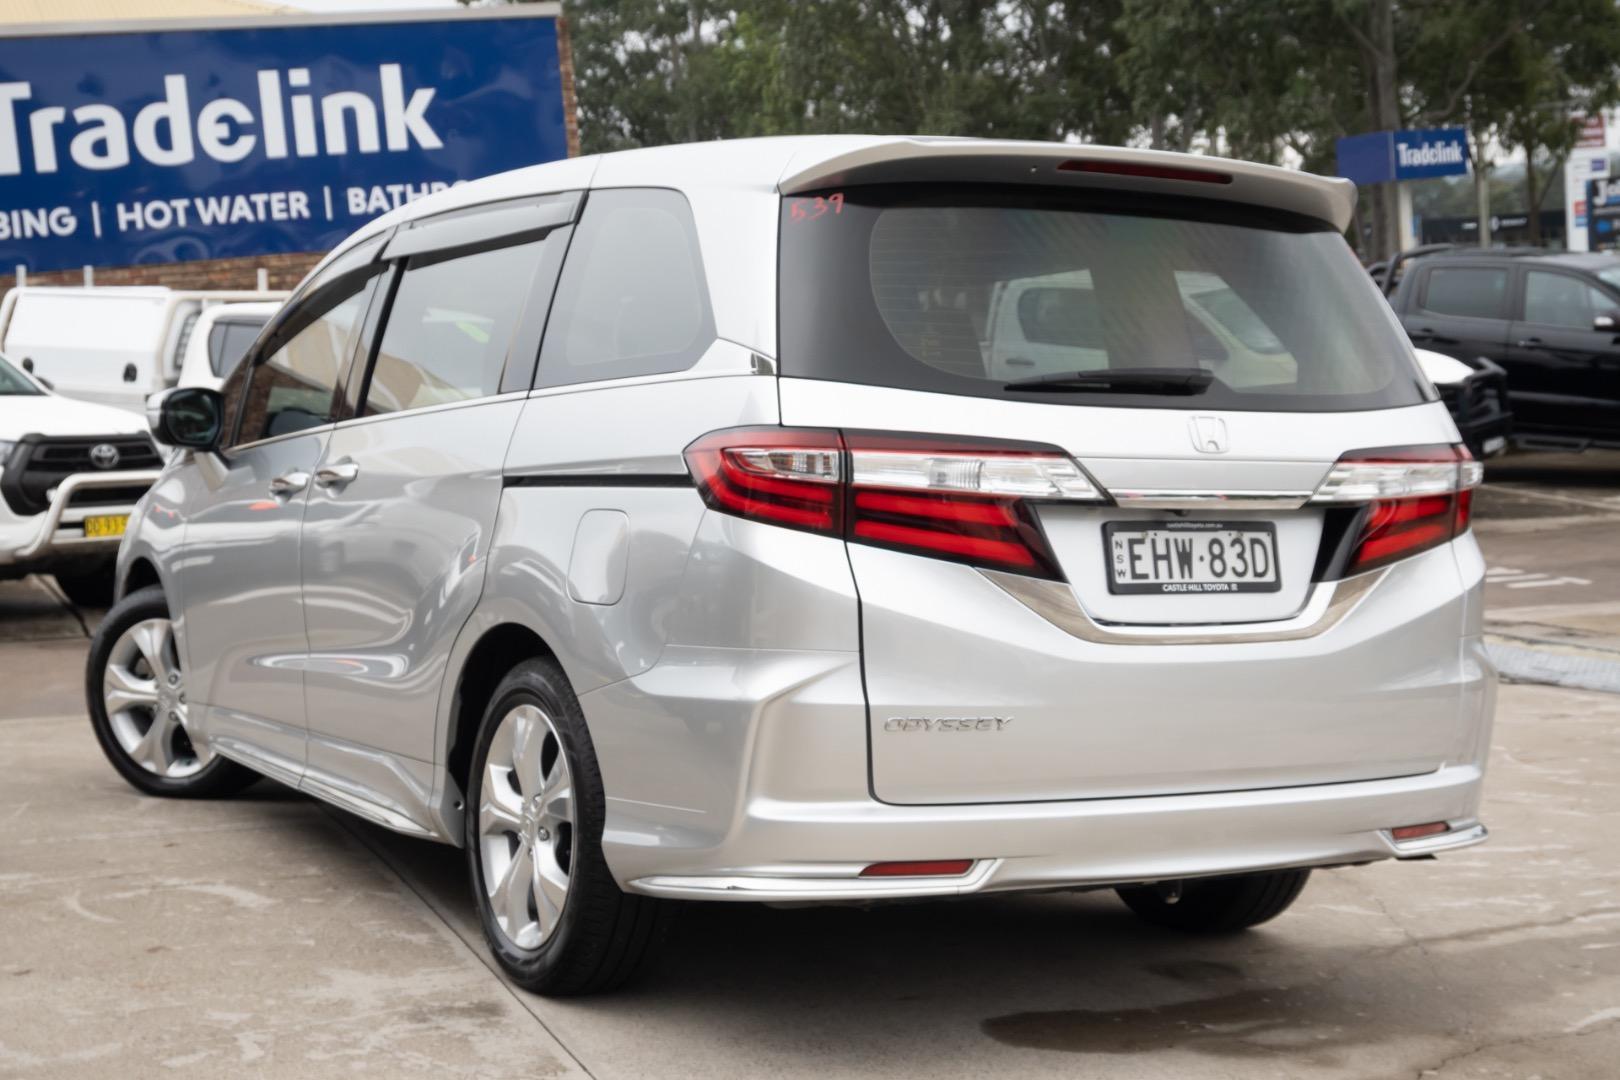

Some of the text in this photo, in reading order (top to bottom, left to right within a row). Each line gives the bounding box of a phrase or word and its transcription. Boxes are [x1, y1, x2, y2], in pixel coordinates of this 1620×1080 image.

[0, 63, 444, 175] Tradelink
[1396, 140, 1463, 167] Tradelink
[117, 198, 196, 232] HOT
[194, 191, 311, 225] WATER
[1162, 583, 1229, 592] CASTLE HILL TOYOTA
[884, 716, 1015, 732] ODYSSEY
